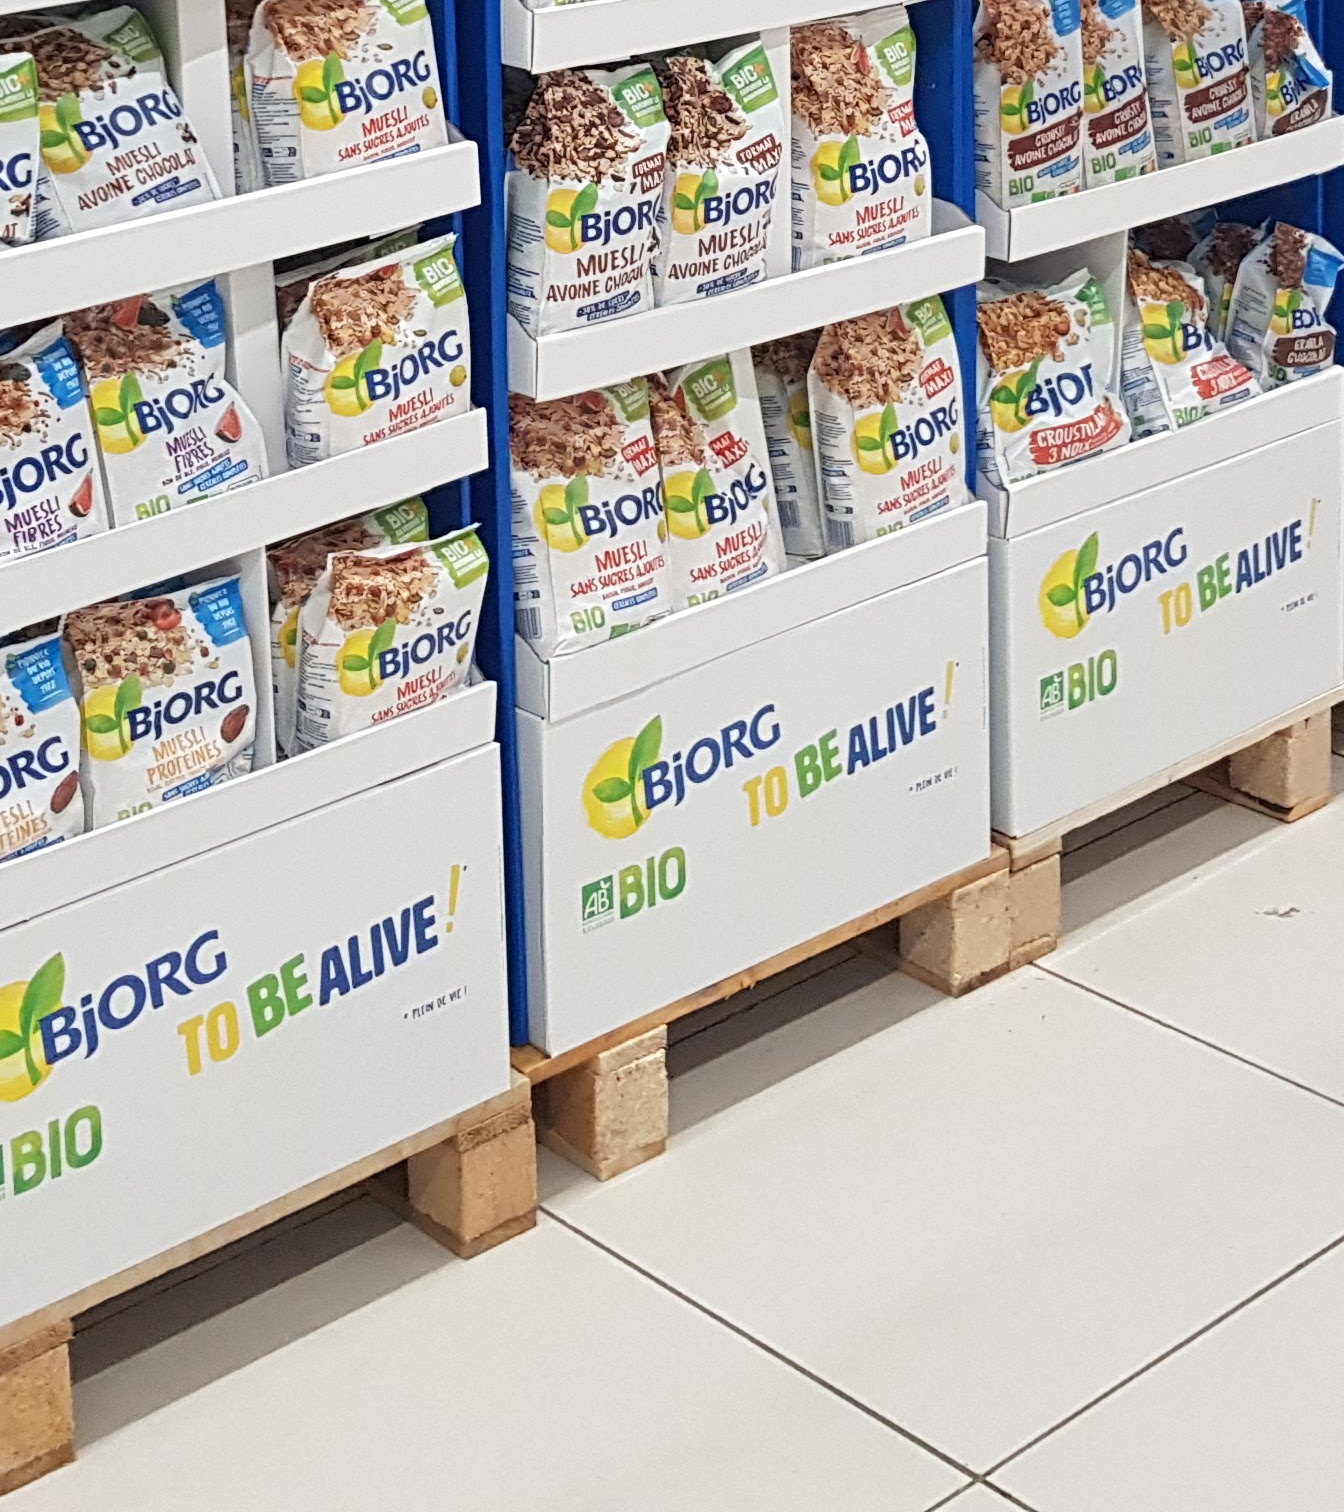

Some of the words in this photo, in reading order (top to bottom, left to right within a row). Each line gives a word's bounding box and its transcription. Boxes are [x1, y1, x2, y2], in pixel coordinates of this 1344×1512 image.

[106, 142, 161, 177] MUESLI
[78, 174, 133, 211] AVOINE
[135, 147, 197, 190] CHOCOLAT
[1009, 175, 1034, 196] BIO
[576, 242, 646, 279] MUESLI
[547, 279, 602, 304] AVOINE
[166, 426, 207, 456] MUESLI
[175, 441, 215, 473] FIBRES
[595, 540, 648, 573] MUESLI
[1158, 582, 1193, 635] TO
[1197, 552, 1234, 612] BE
[1236, 519, 1303, 594] ALIVE
[570, 604, 605, 634] BIO
[1067, 649, 1118, 710] BIO
[152, 726, 205, 762] MUESLI
[743, 764, 789, 828] TO
[794, 728, 843, 799] BE
[847, 686, 937, 776] ALIVE
[618, 846, 687, 920] BIO
[176, 1000, 240, 1077] TO
[245, 952, 314, 1039] BE
[318, 894, 440, 1007] ALIVE
[10, 1104, 103, 1197] BIO
